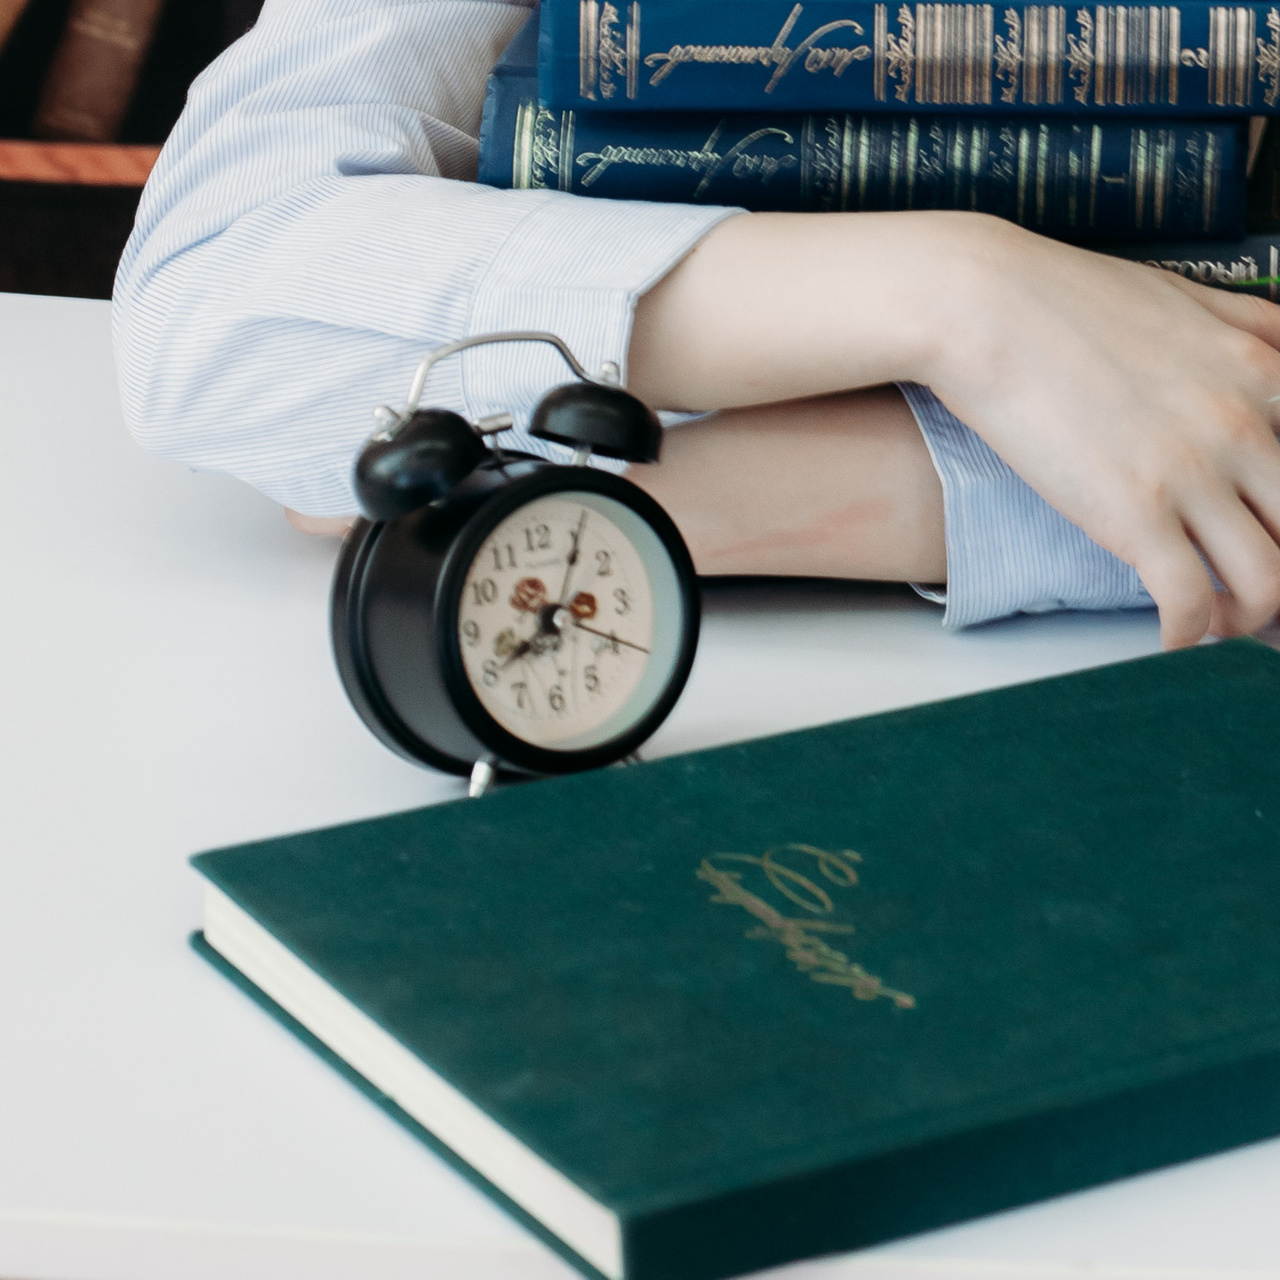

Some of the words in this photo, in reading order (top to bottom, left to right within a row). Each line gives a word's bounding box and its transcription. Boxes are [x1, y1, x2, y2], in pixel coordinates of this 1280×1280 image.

[1181, 47, 1209, 69] 2
[525, 524, 550, 552] 12
[492, 544, 518, 571] 11
[595, 550, 613, 577] 2
[471, 578, 498, 605] 10
[612, 588, 631, 615] 3
[463, 620, 480, 647] 9
[482, 659, 499, 687] 8
[584, 664, 601, 691] 5
[510, 682, 527, 709] 7
[549, 685, 566, 711] 6
